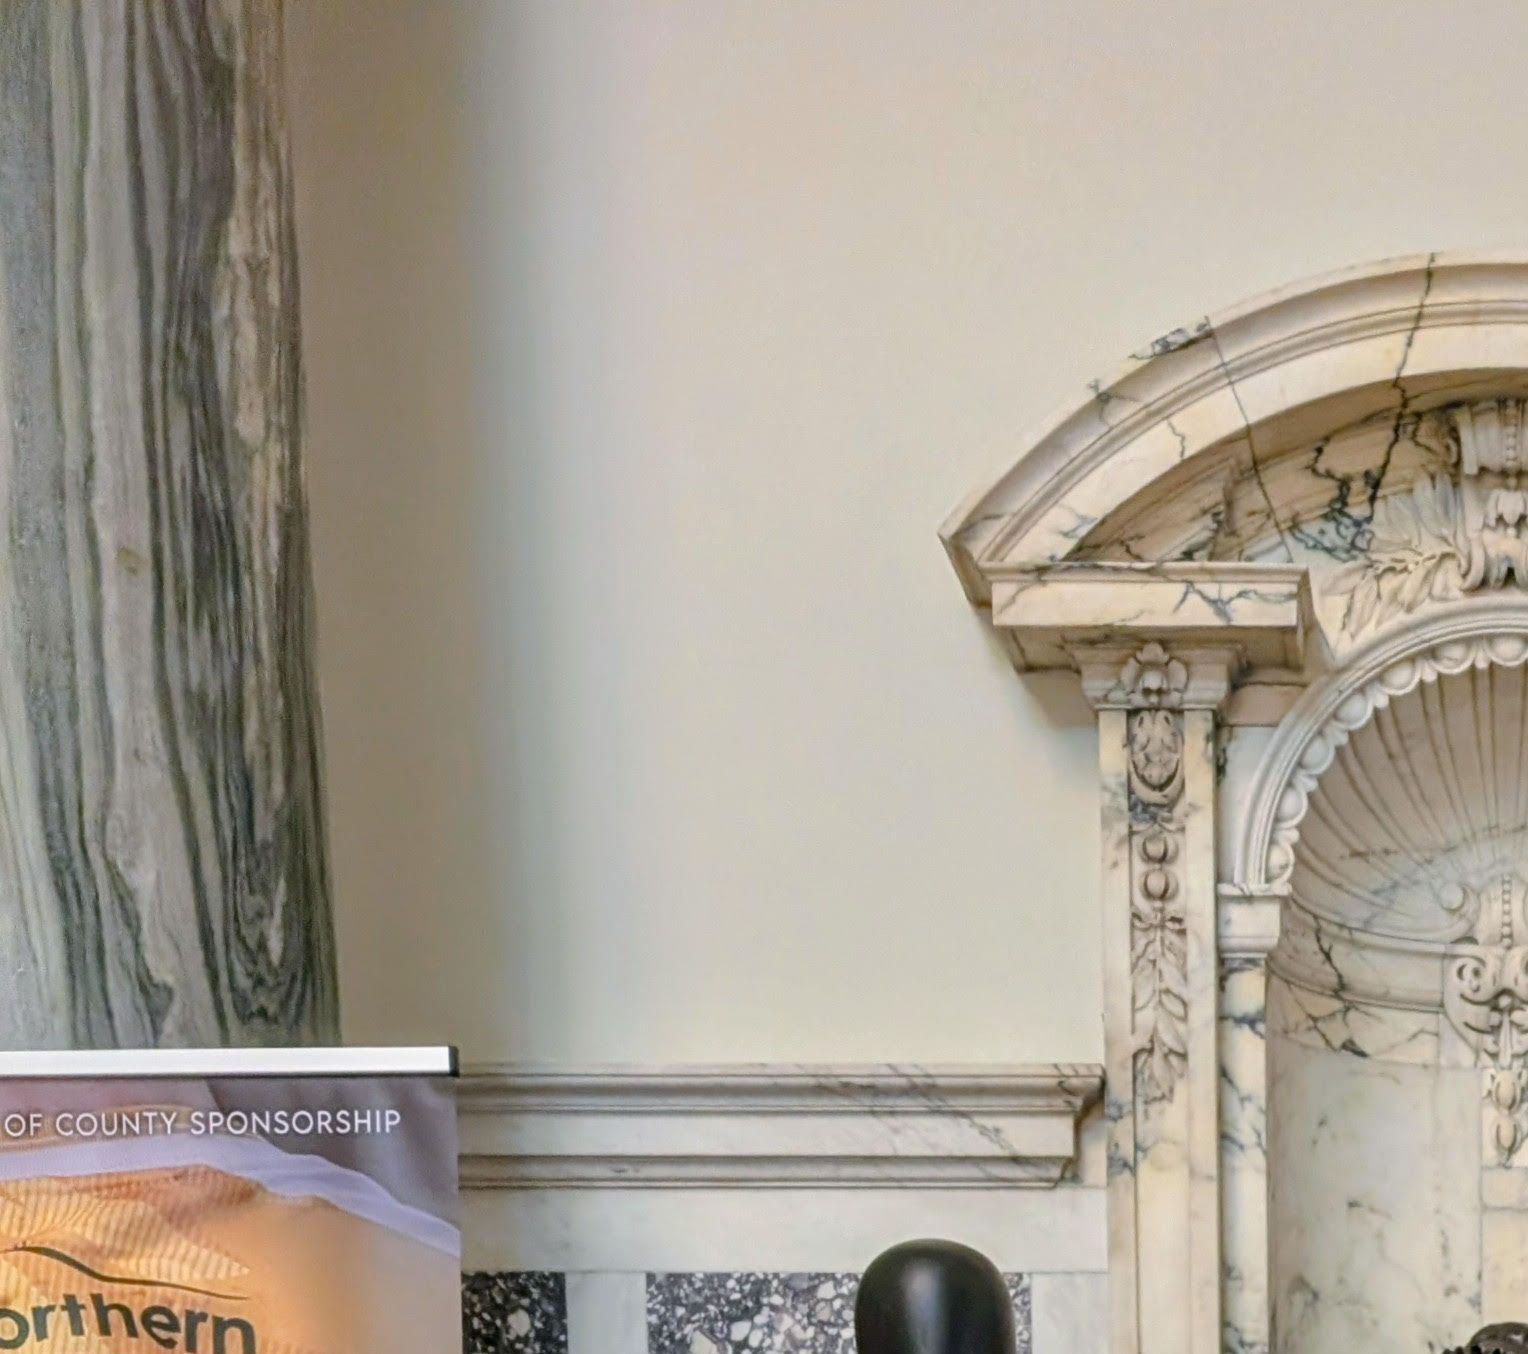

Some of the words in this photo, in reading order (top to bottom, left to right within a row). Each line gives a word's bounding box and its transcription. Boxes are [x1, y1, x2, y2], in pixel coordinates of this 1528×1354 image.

[4, 1113, 43, 1137] OF
[55, 1111, 176, 1137] COUNTY
[190, 1109, 402, 1136] SPONSORSHIP
